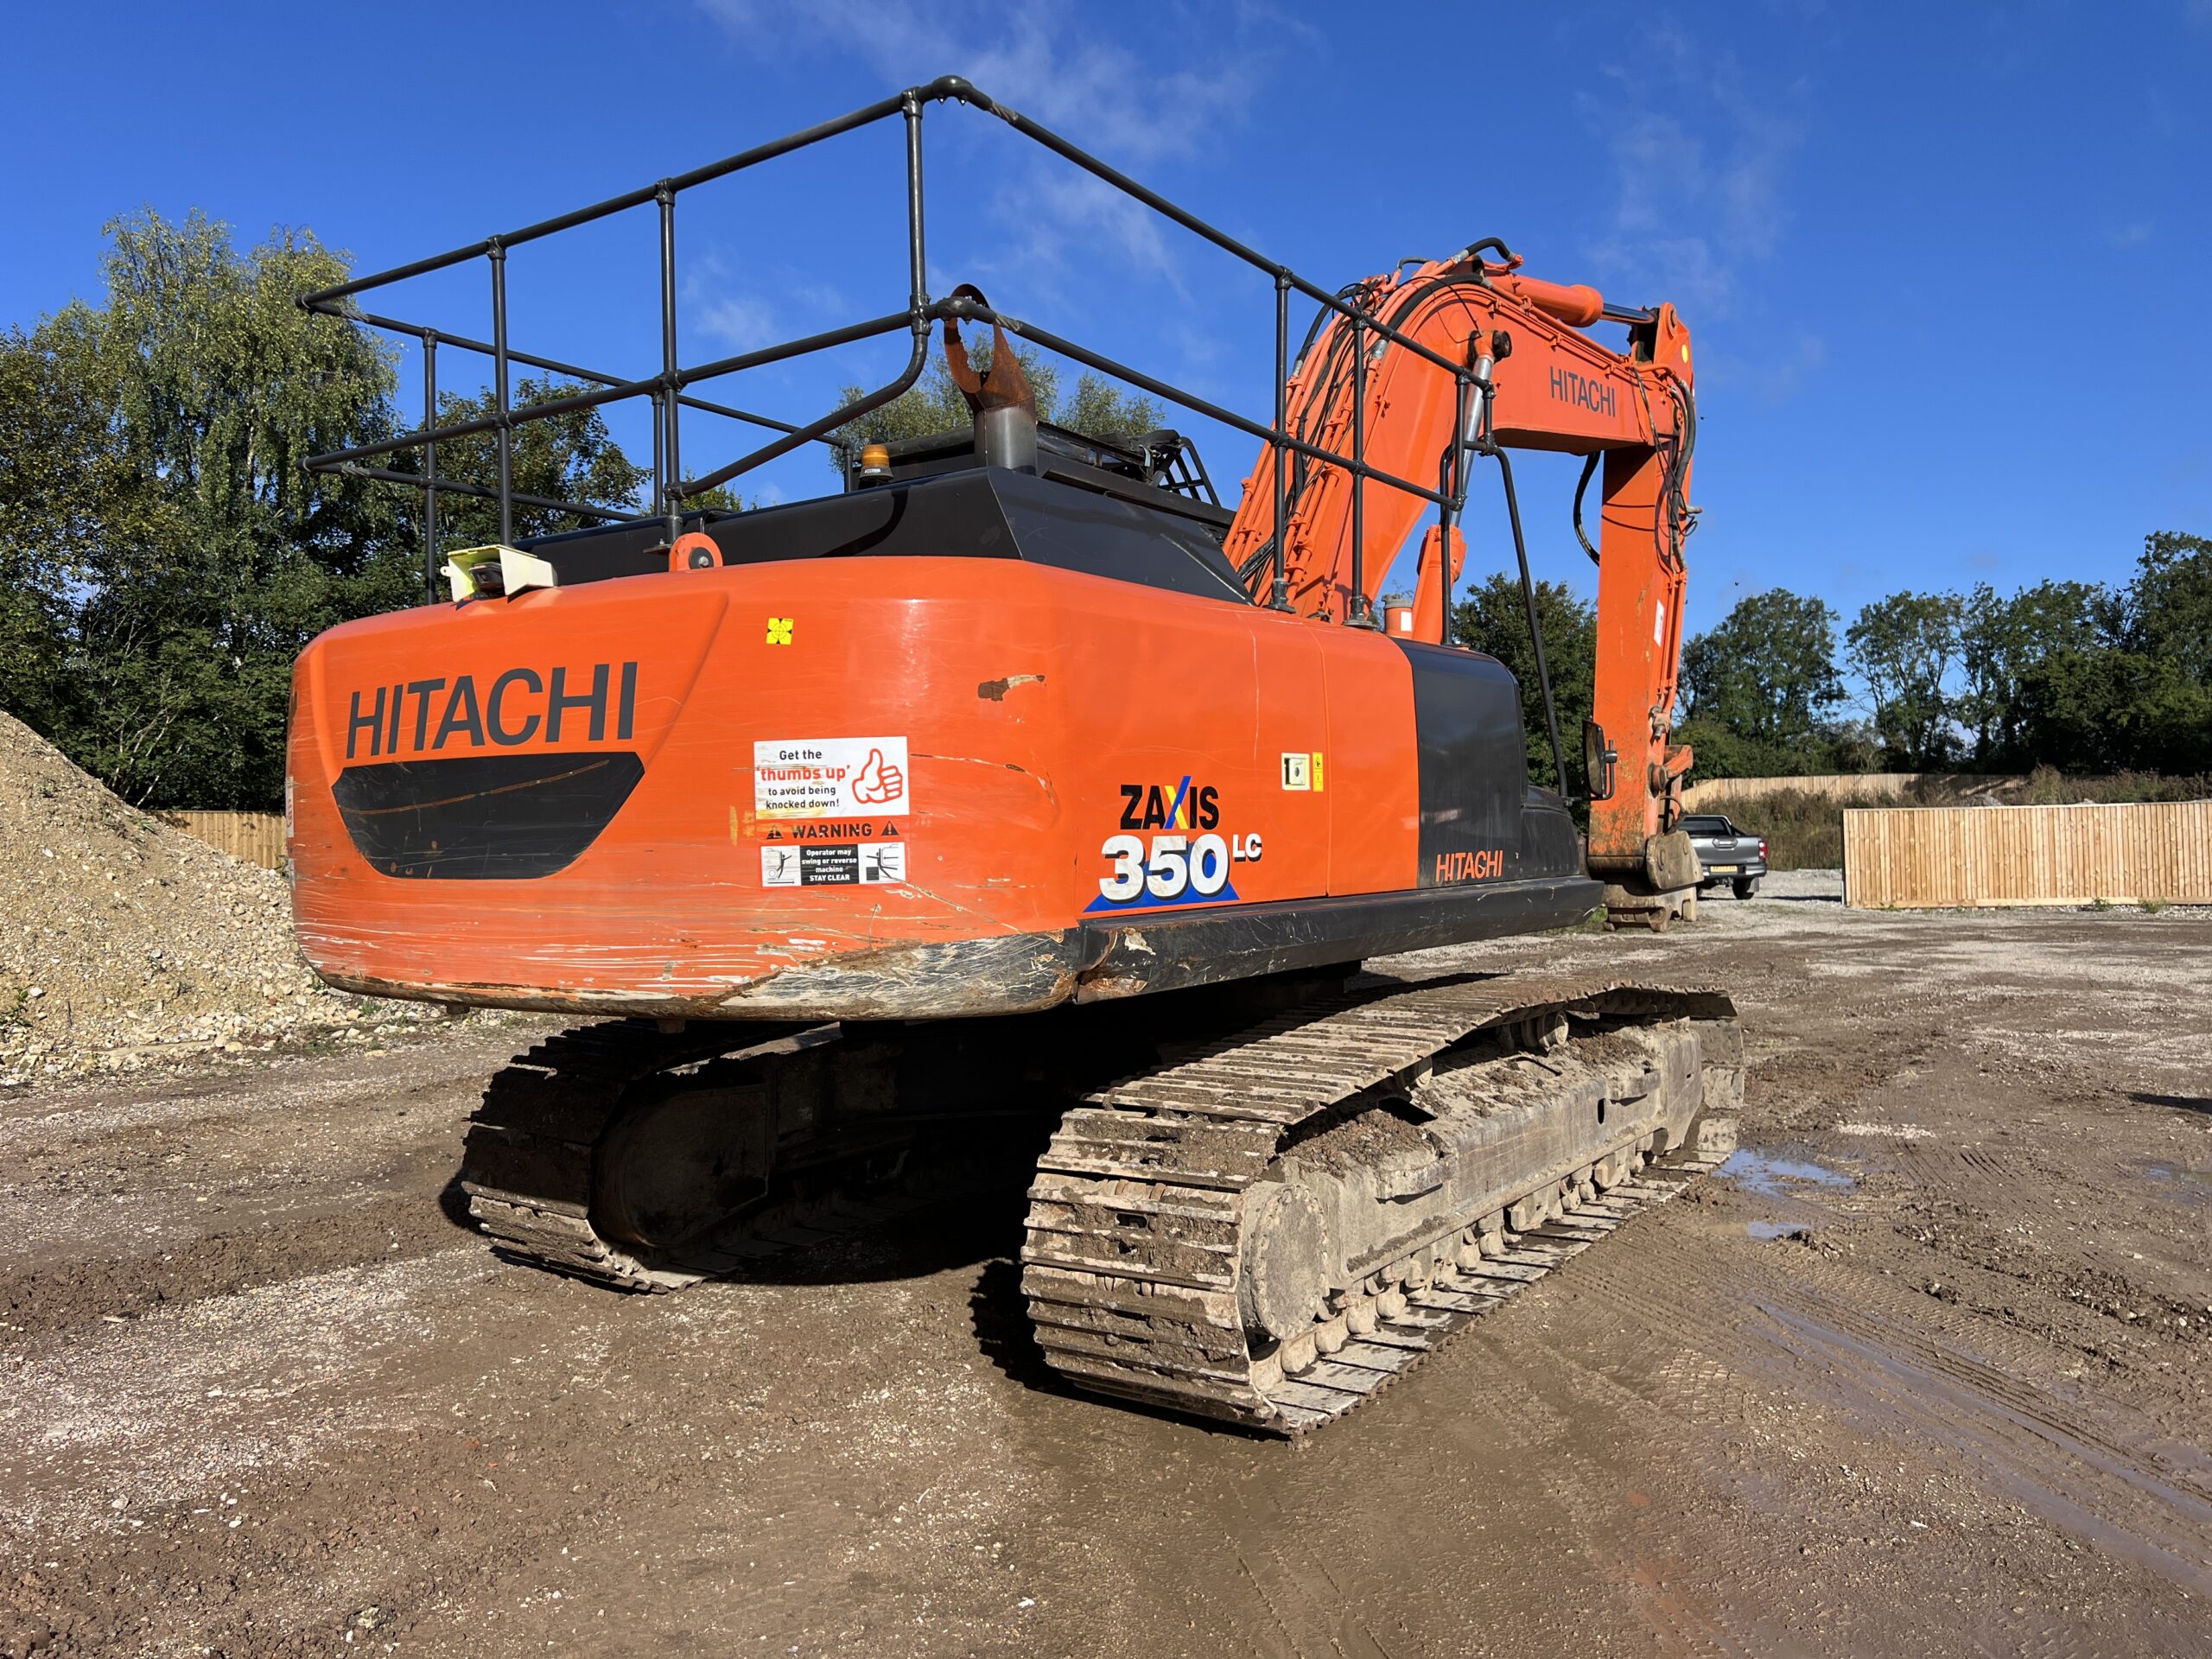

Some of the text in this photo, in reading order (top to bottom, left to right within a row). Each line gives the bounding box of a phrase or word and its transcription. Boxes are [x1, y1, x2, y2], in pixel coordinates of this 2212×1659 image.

[1550, 365, 1616, 418] HITACHI
[346, 662, 638, 759] HITACHI
[779, 749, 823, 760] Get the
[766, 798, 840, 810] knocked down!
[779, 786, 805, 796] avoid
[808, 785, 836, 796] being
[1120, 776, 1220, 830] ZAXIS
[791, 823, 873, 839] WARNING
[1098, 833, 1262, 904] 350 LC
[1435, 850, 1503, 882] HITACHI
